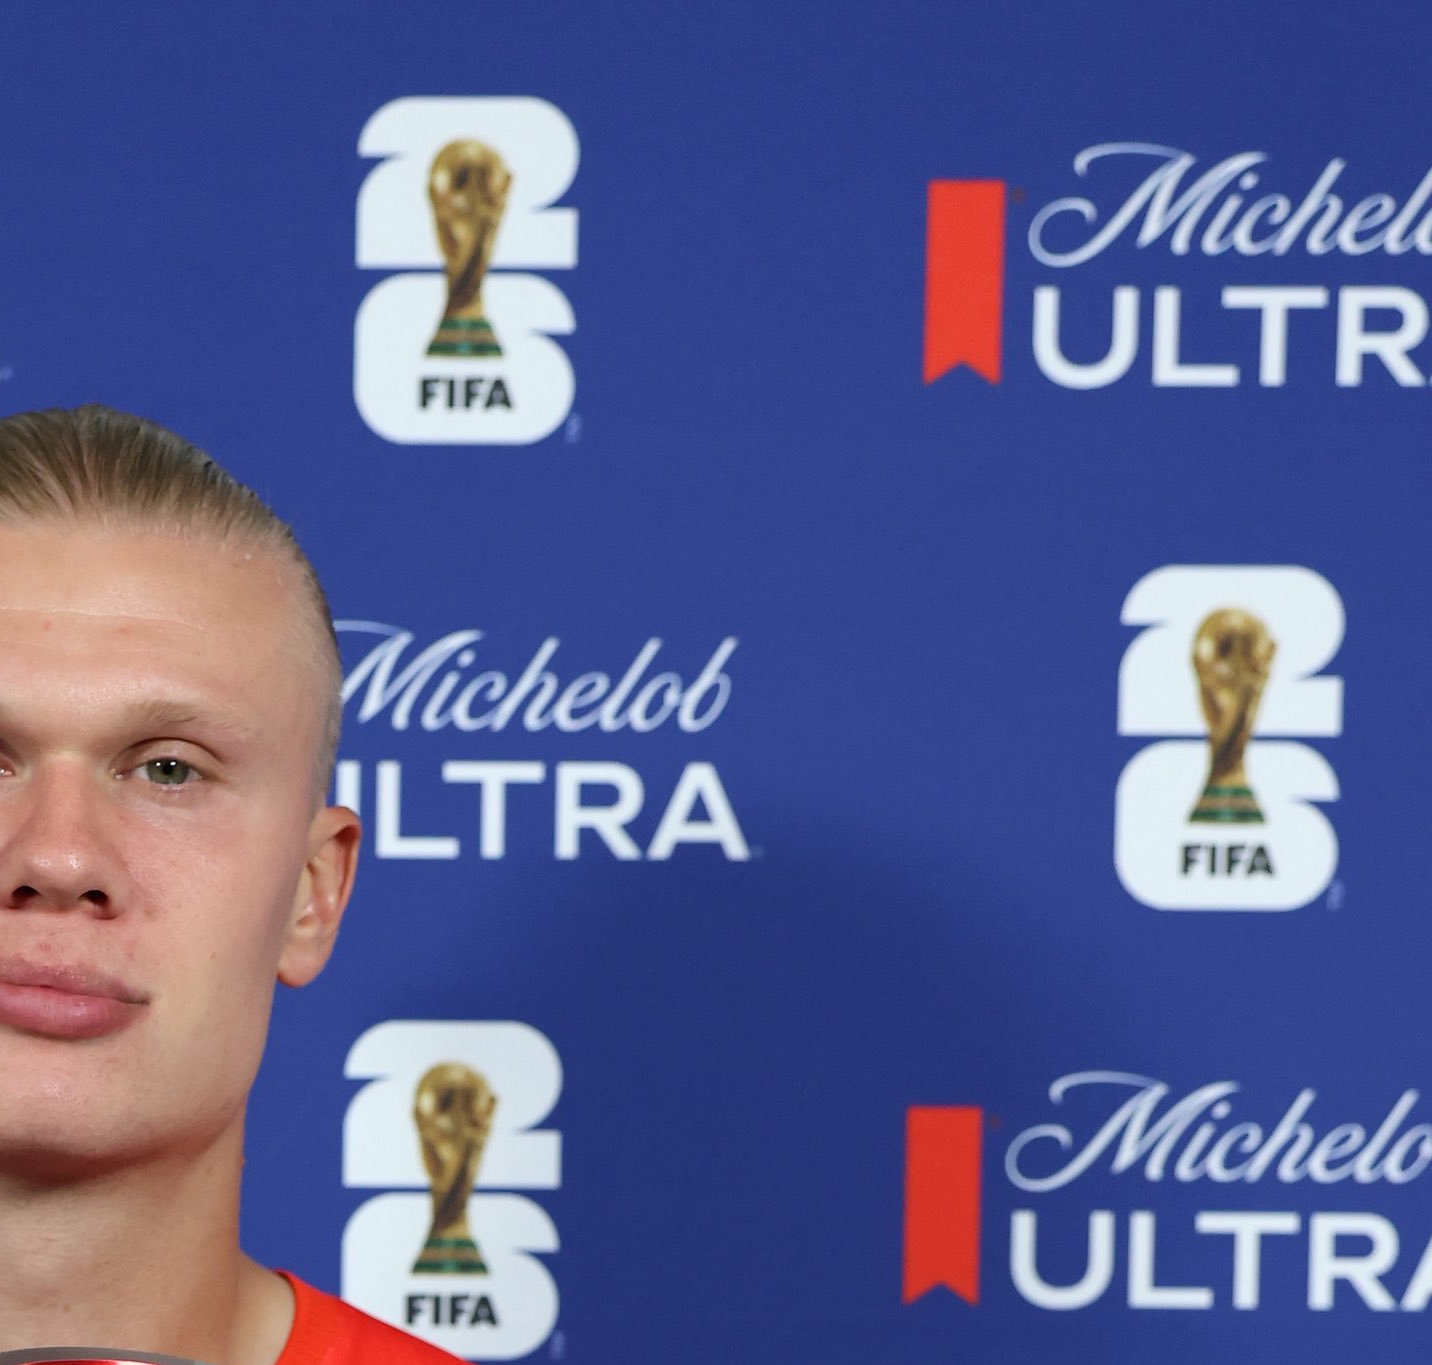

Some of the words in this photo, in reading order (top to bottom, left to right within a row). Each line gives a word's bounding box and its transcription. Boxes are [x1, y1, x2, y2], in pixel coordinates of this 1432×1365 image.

[1028, 143, 1432, 267] Michel
[1033, 286, 1432, 389] ULTR
[419, 377, 513, 410] FIFA
[335, 760, 751, 861] LTRA
[1180, 844, 1275, 877] FIFA
[405, 1295, 499, 1328] FIFA
